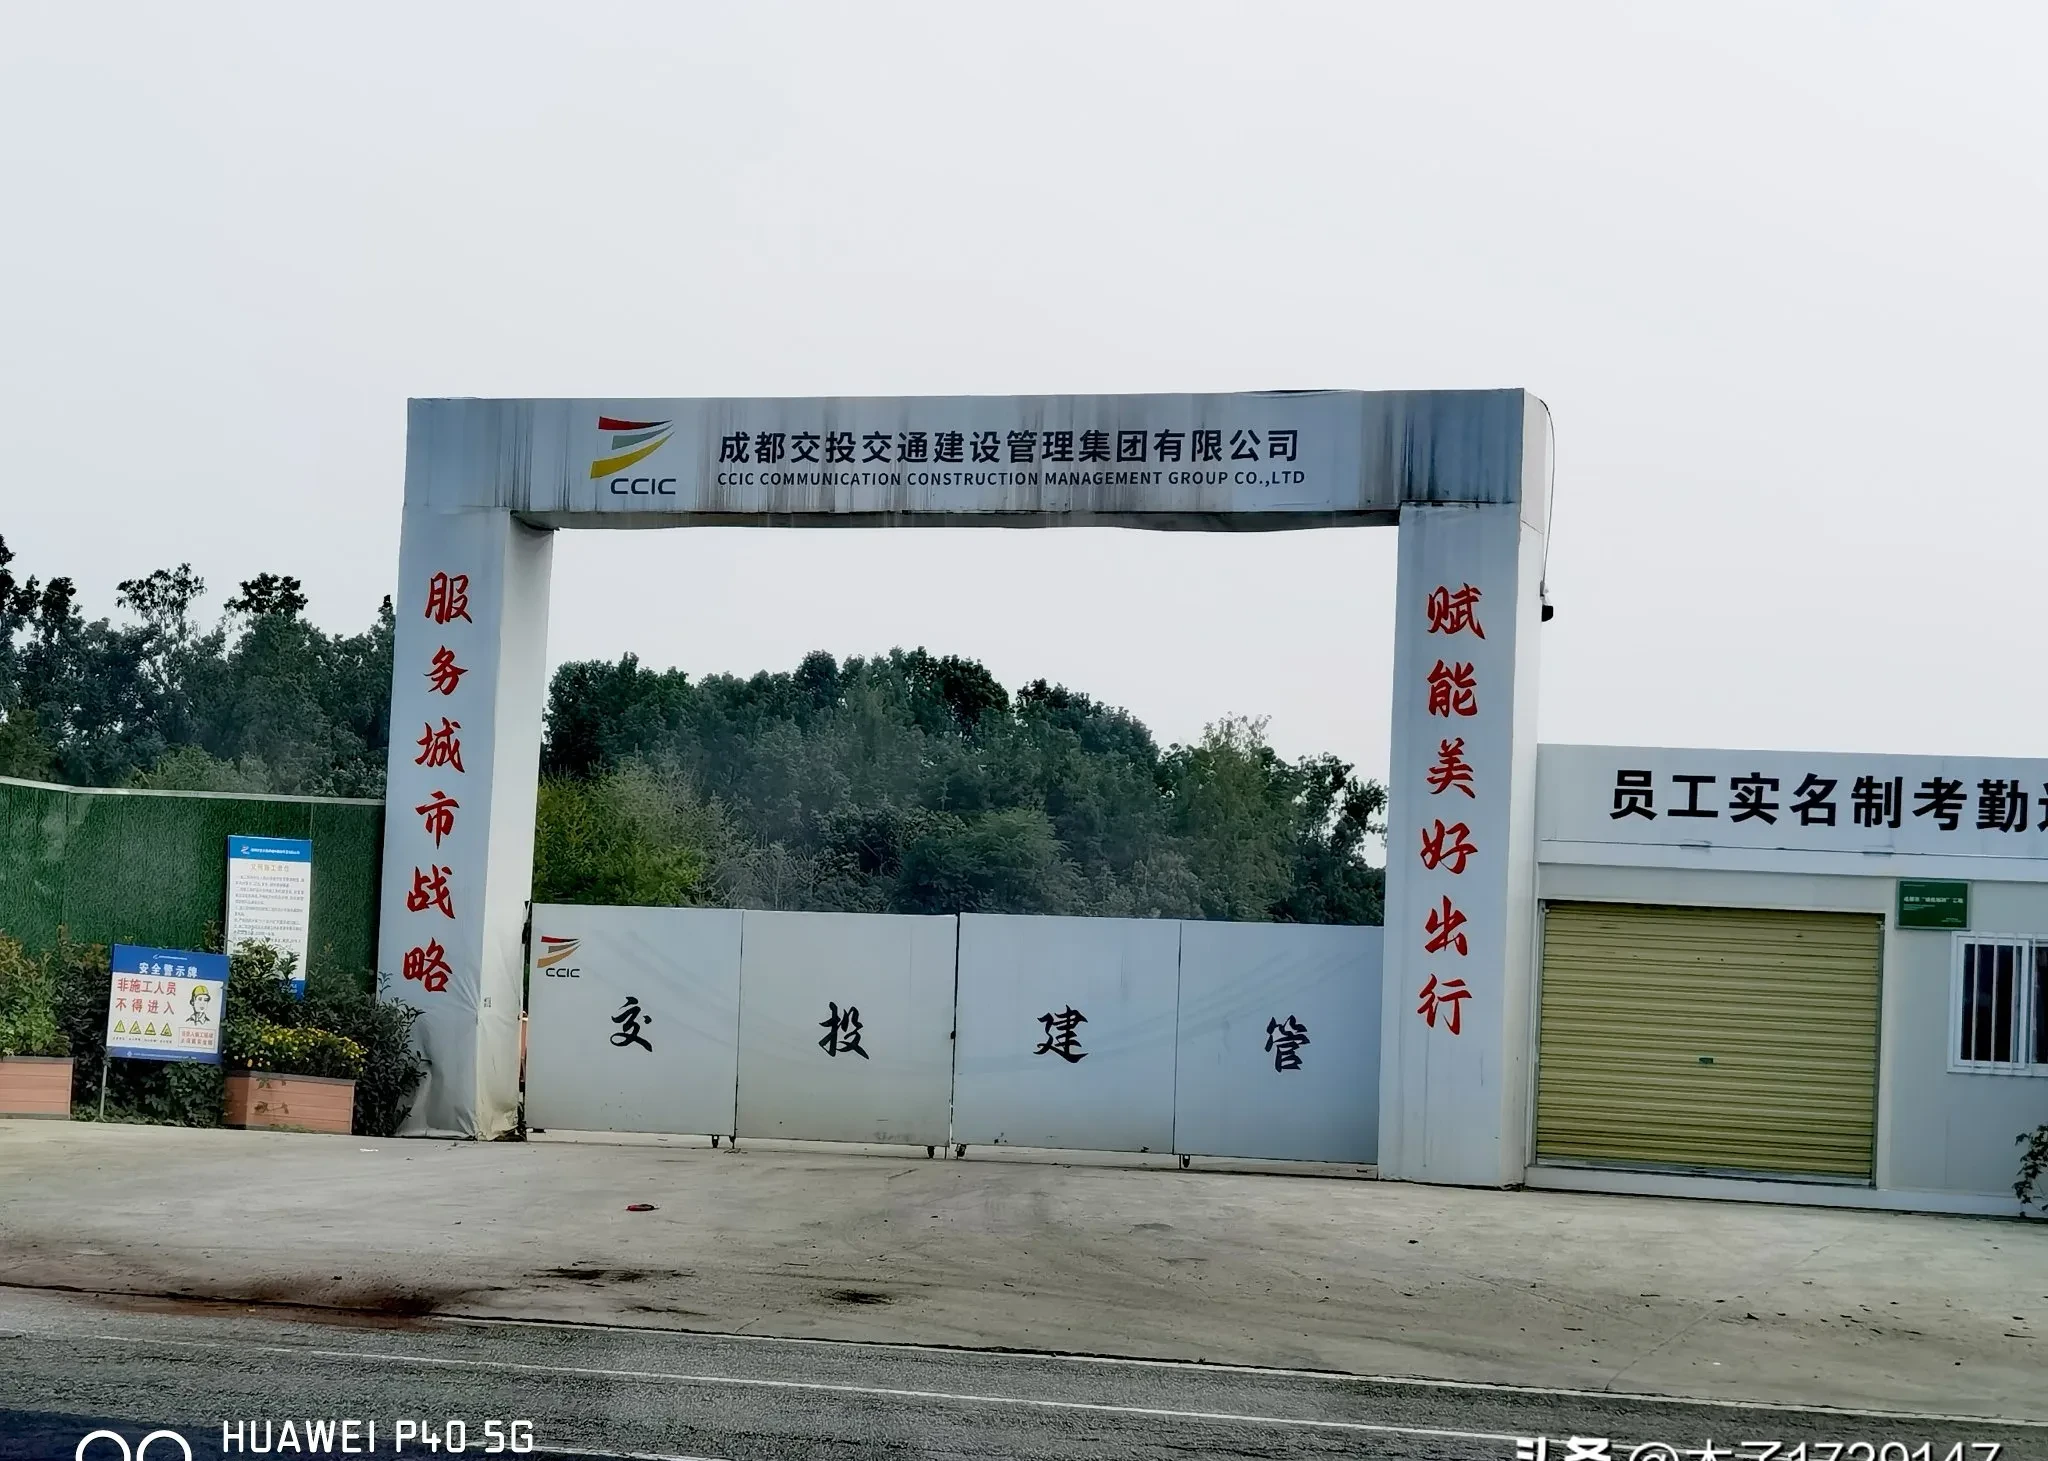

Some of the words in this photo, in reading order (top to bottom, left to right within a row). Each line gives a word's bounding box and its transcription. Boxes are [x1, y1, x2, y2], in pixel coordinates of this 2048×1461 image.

[718, 429, 1299, 464] 成都交投交通建设管理集团有限公司
[610, 478, 677, 495] CCIC
[717, 472, 754, 486] CCIC
[759, 472, 901, 486] COMMUNICATION
[907, 472, 1038, 486] CONSTRUCTION
[1045, 471, 1163, 486] MANAGEMENT
[1168, 471, 1228, 485] GROUP
[1234, 470, 1305, 487] CO.,LTD
[403, 572, 473, 993] 服务城市战略
[1417, 583, 1486, 1036] 赋能美好出行
[1610, 769, 2048, 833] 员工实名制考勤
[139, 962, 198, 978] 安全警示牌
[545, 967, 580, 978] CCIC
[117, 978, 177, 996] 非施工人员
[115, 997, 175, 1015] 不得进入
